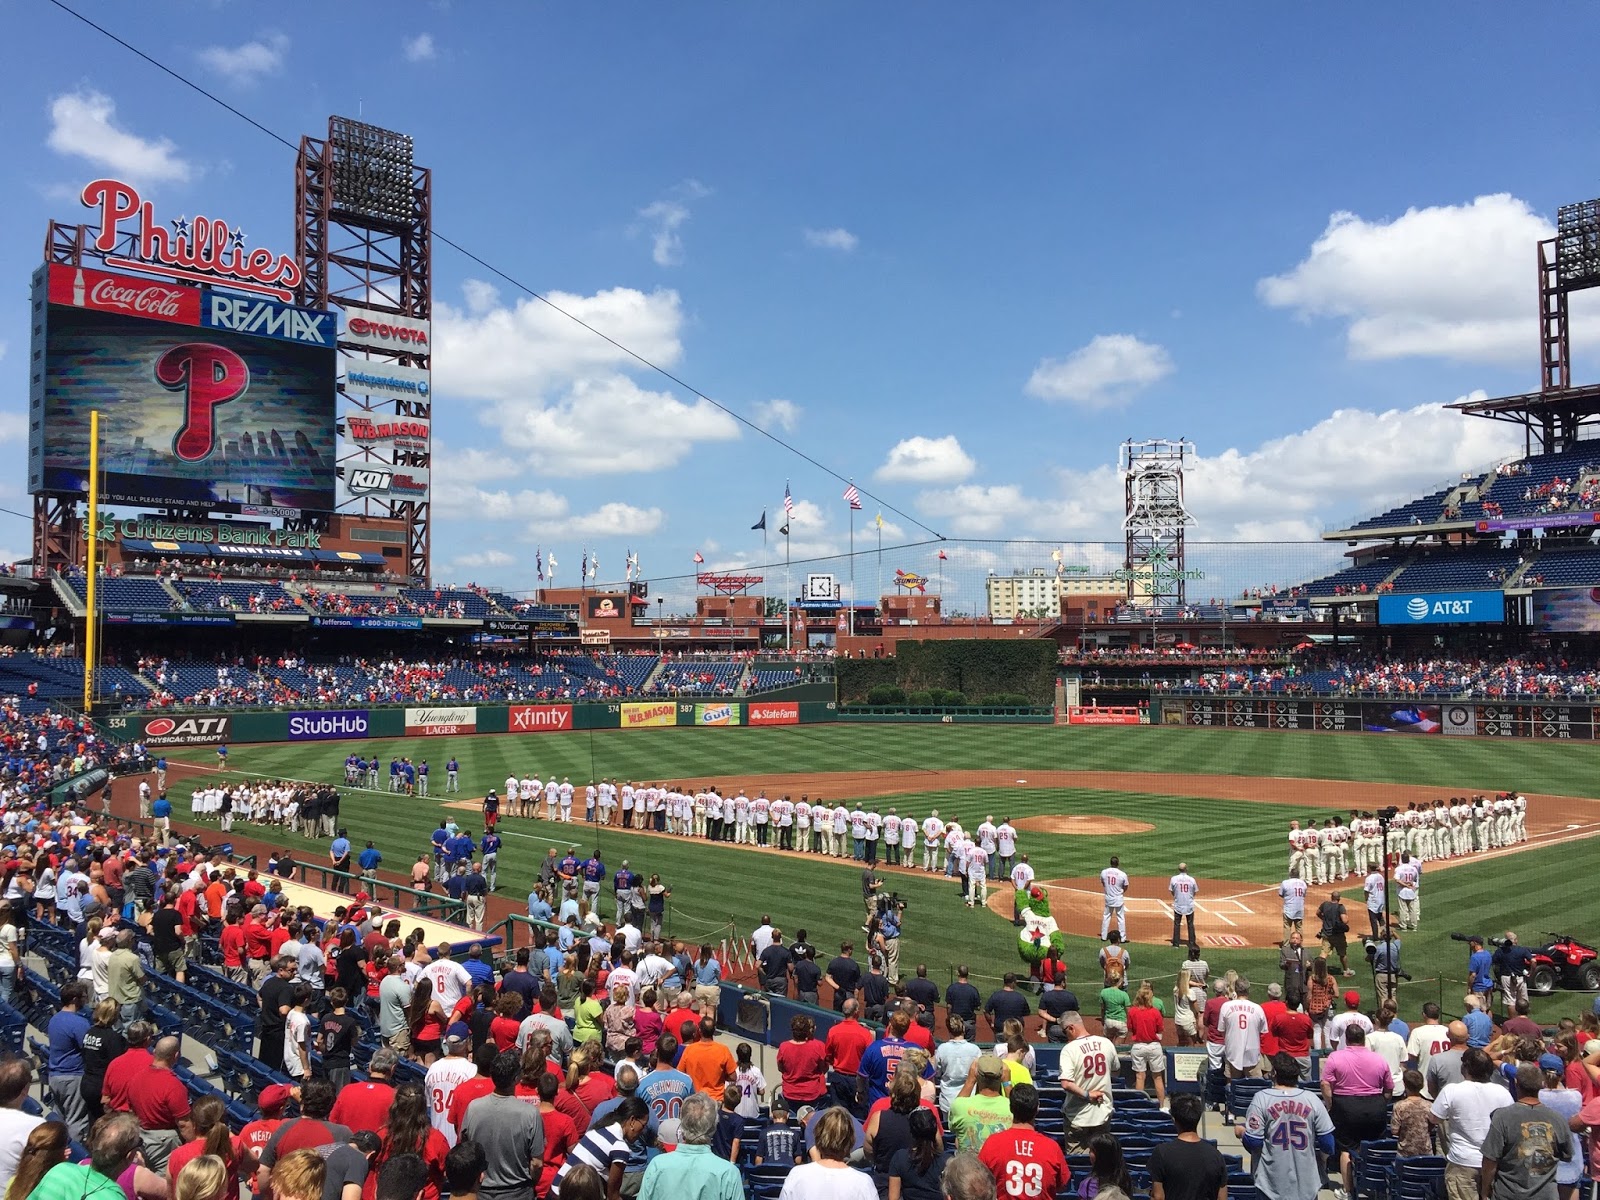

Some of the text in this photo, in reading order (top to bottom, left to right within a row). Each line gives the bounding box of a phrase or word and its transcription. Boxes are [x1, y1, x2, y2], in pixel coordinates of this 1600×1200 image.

[82, 178, 302, 293] Phillies
[92, 279, 185, 317] Coca-Cola
[211, 295, 326, 344] RE/MAX
[369, 322, 428, 345] TOYOTA
[112, 494, 126, 502] YOU
[140, 497, 163, 505] PLEASE
[272, 508, 296, 518] 5,000
[121, 519, 322, 551] Citizens Bank Park
[894, 577, 928, 587] SUNOCO
[1144, 582, 1172, 594] Park
[1433, 600, 1474, 615] AT&T
[497, 622, 530, 630] NovaCare
[608, 705, 619, 713] 374
[680, 705, 693, 713] 387
[703, 708, 732, 721] Gulf
[109, 719, 126, 728] 334
[414, 710, 469, 725] Yuengling
[513, 709, 569, 730] xfinity
[173, 718, 228, 735] ATI
[290, 717, 368, 735] StubHub
[426, 725, 457, 736] LAGER
[187, 735, 223, 743] THERAPY
[999, 832, 1008, 840] 25
[1308, 835, 1317, 843] 19
[974, 854, 983, 863] 10
[1017, 871, 1025, 881] 10
[1107, 876, 1117, 886] 10
[1405, 873, 1413, 882] 10
[66, 885, 78, 898] 34
[1180, 883, 1189, 893] 10
[1294, 887, 1303, 897] 10
[431, 965, 452, 976] HOWARD
[437, 974, 445, 993] 6
[1238, 1014, 1247, 1030] 6
[1079, 1041, 1102, 1054] UTLEY
[1083, 1053, 1106, 1079] 26
[647, 1079, 685, 1099] SCHMIDT
[651, 1096, 683, 1121] 20
[1271, 1120, 1309, 1151] 45
[1014, 1139, 1035, 1157] LEE
[1005, 1160, 1044, 1197] 33
